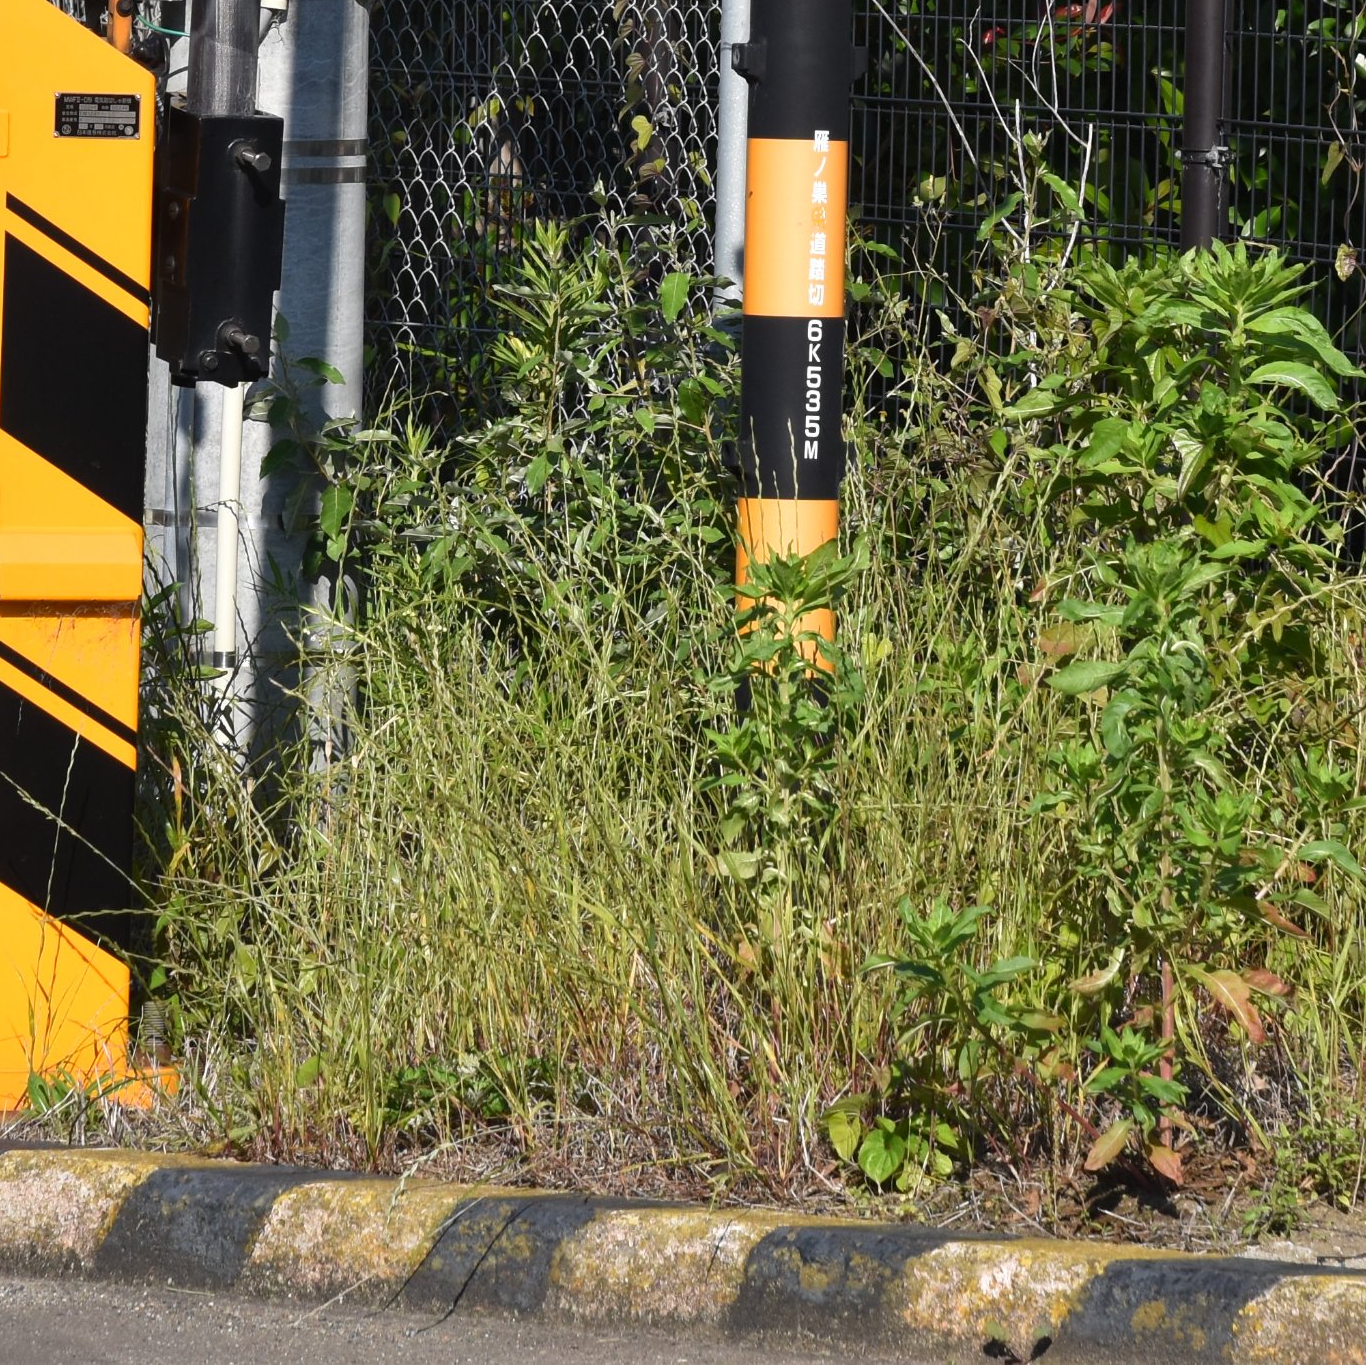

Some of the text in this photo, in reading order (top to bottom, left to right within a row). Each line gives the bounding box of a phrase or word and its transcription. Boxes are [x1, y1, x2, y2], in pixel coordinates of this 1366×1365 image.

[803, 130, 830, 461] 雁ノ巣道踏切 6K535M
